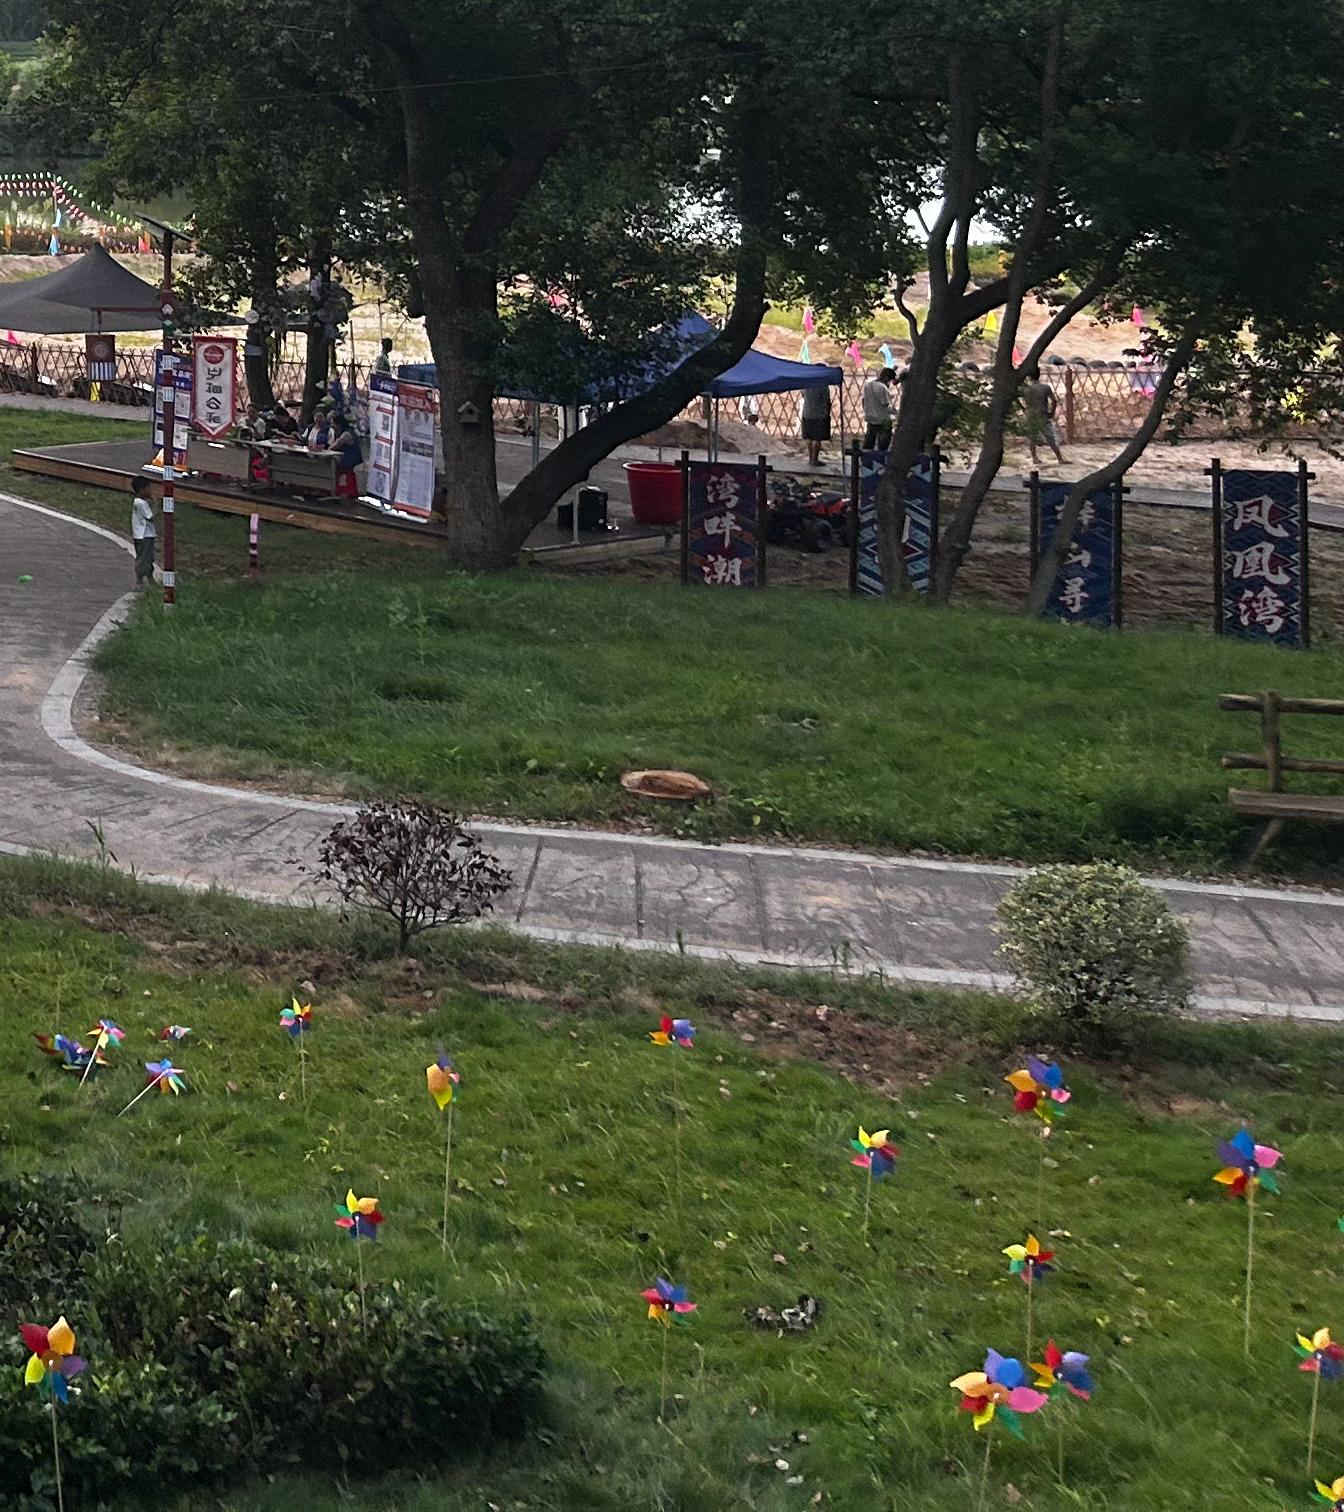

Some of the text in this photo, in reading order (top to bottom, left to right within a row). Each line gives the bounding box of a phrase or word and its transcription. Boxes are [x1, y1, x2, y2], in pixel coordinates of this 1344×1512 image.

[702, 472, 743, 586] 湾畔潮
[1233, 494, 1292, 634] 凤凰湾
